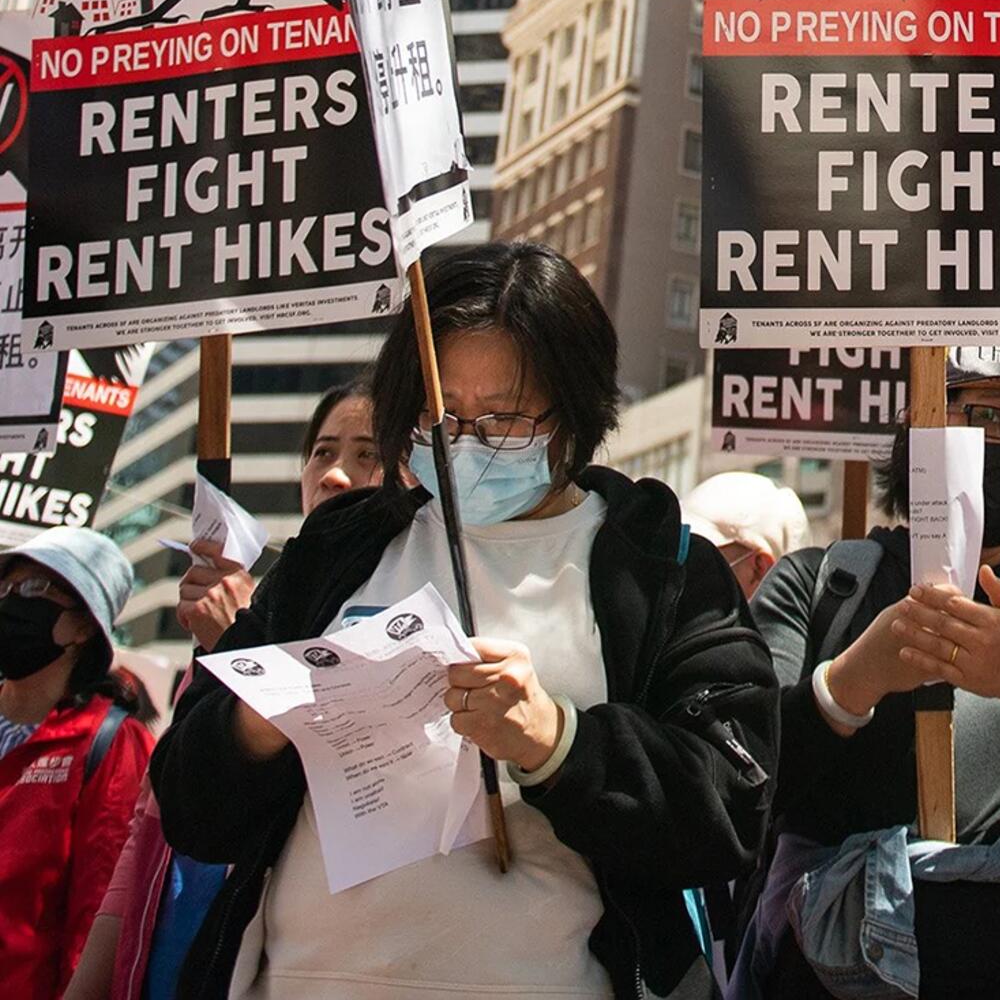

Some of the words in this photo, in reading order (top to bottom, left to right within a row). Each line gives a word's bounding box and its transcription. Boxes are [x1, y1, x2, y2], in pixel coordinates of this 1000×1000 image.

[40, 41, 83, 79] NO
[90, 31, 213, 75] PREYING
[219, 23, 260, 58] ON
[267, 12, 357, 51] TENAN
[713, 10, 762, 43] NO
[770, 11, 918, 44] PREYING
[927, 12, 976, 44] ON
[79, 68, 358, 158] RENTERS
[125, 144, 309, 223] FIGHT
[36, 230, 195, 302] RENT
[213, 206, 392, 284] HIKES
[716, 229, 899, 292] RENT
[752, 320, 784, 328] TENANTS
[785, 320, 813, 328] ACROSS
[823, 320, 838, 328] ARE
[839, 320, 884, 328] ORGANIZING
[64, 379, 131, 409] ENANTS
[722, 374, 843, 422] RENT
